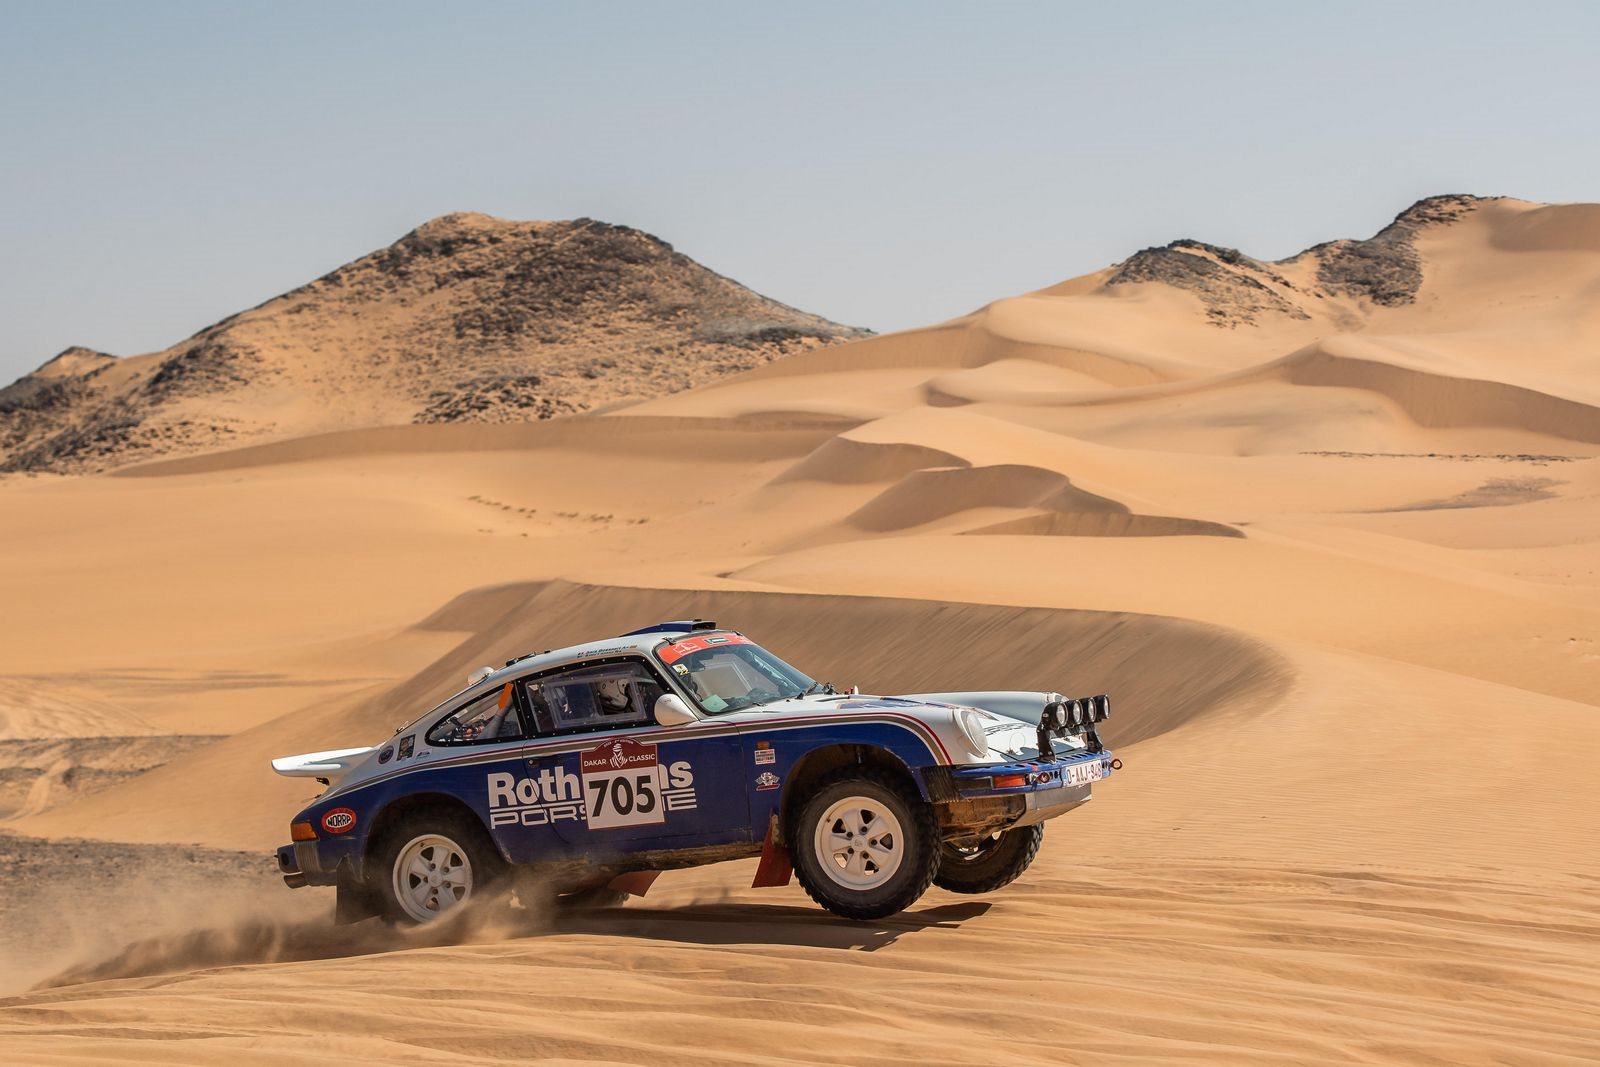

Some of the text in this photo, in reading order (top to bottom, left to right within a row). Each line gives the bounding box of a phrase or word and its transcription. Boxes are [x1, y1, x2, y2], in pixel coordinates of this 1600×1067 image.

[583, 753, 656, 767] DAKAR CLASSIC
[588, 775, 656, 818] 705
